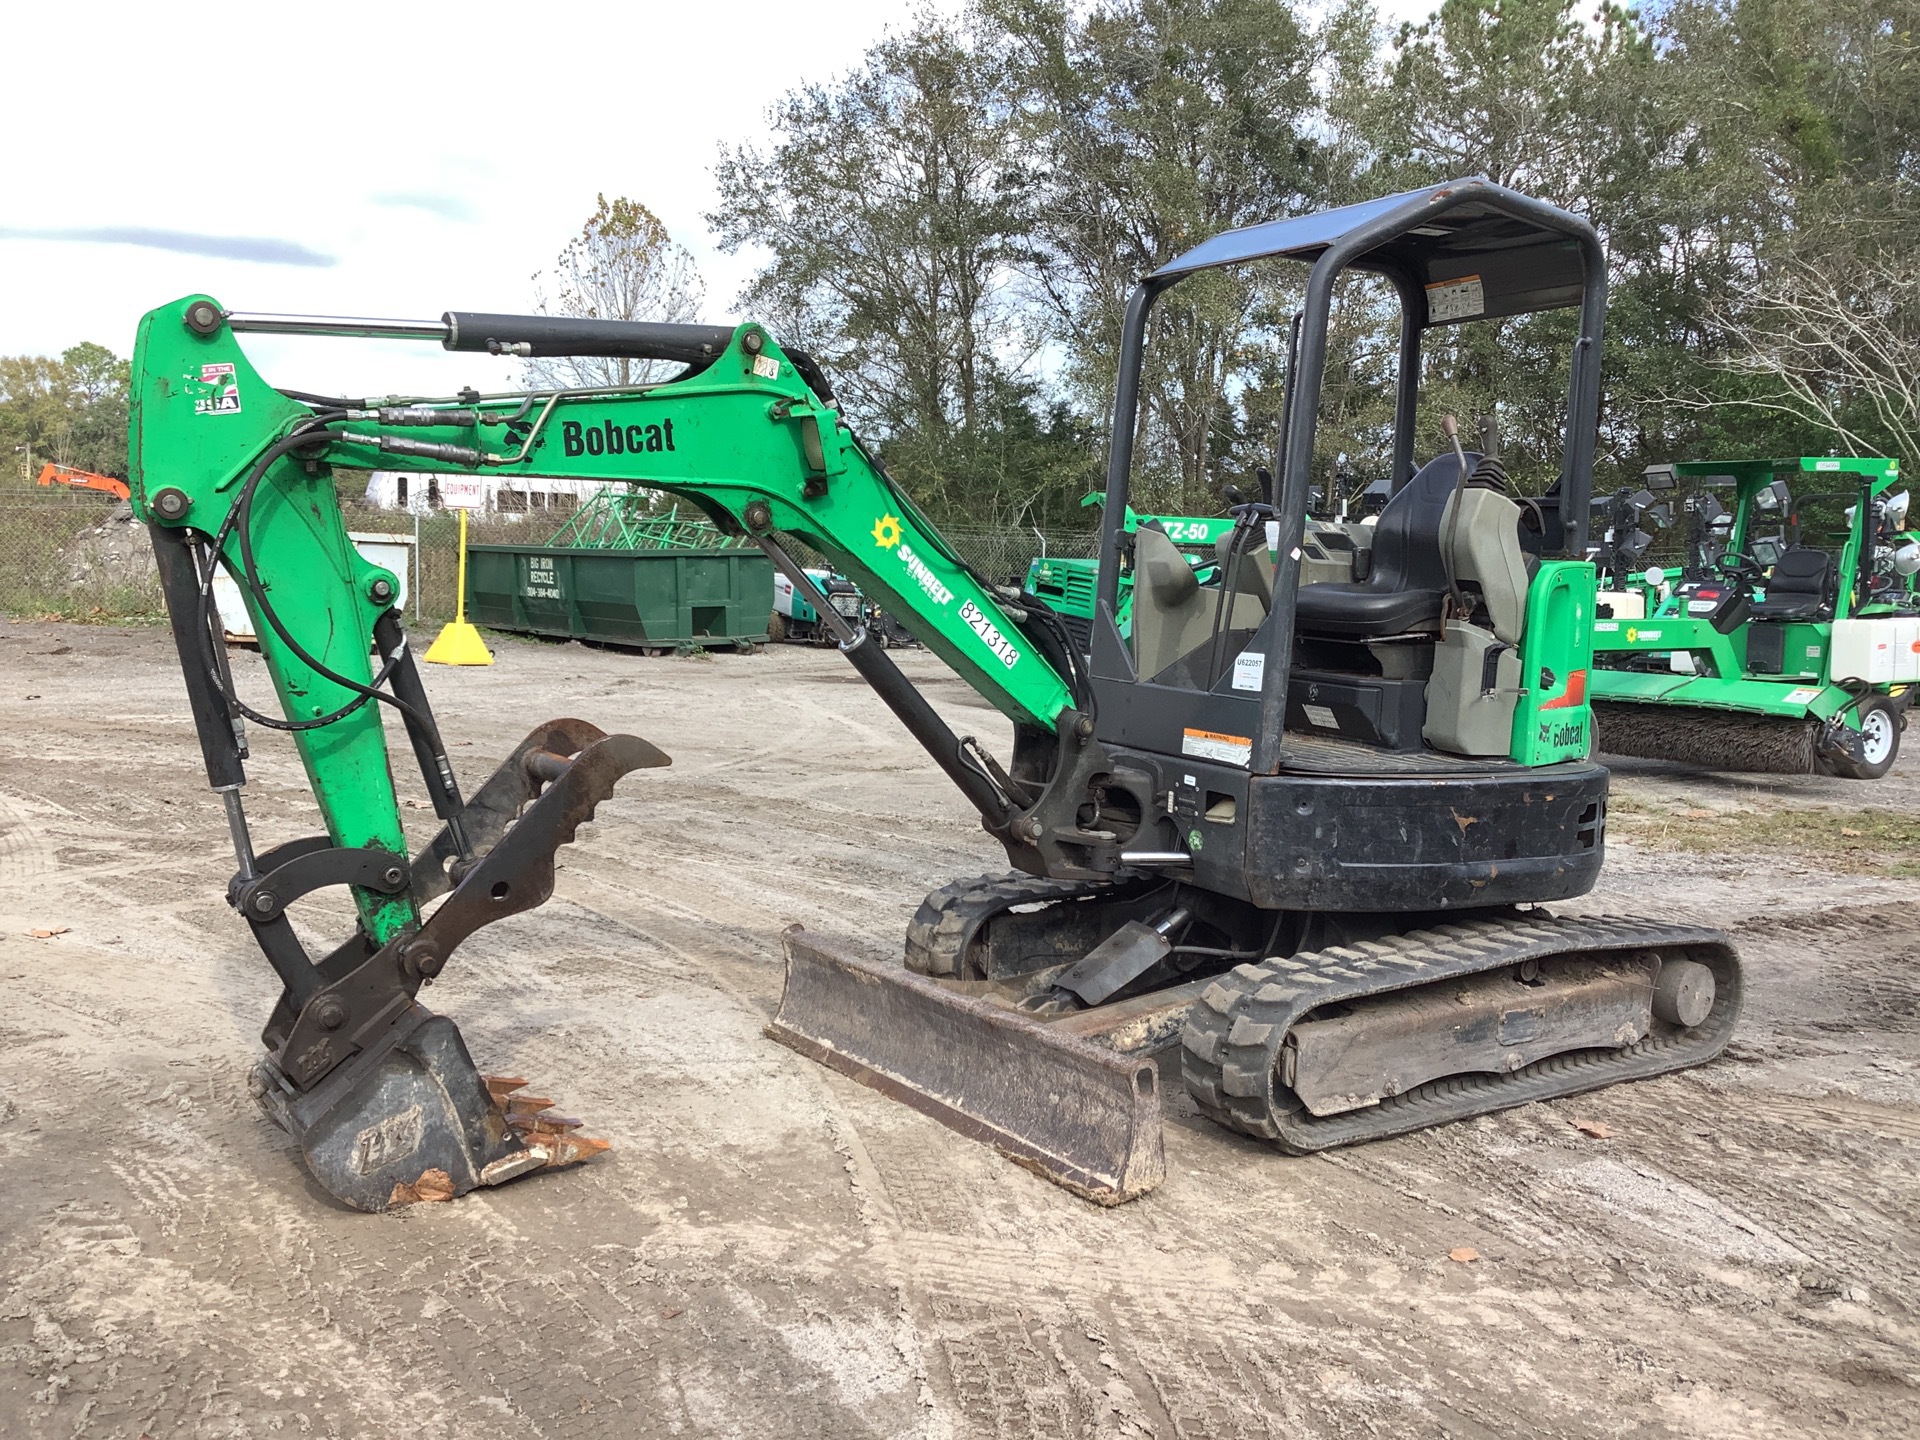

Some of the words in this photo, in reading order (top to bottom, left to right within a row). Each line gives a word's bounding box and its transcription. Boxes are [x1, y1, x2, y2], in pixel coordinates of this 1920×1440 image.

[562, 418, 675, 457] Bobcat
[446, 483, 480, 496] EQUIPMENT
[530, 557, 539, 569] BIG
[540, 557, 553, 570] IRON
[530, 571, 554, 584] RECYCLE
[897, 544, 955, 606] SUNBELT
[961, 602, 1017, 667] 821318
[1237, 659, 1262, 667] U622057
[1553, 721, 1583, 748] Bobcat
